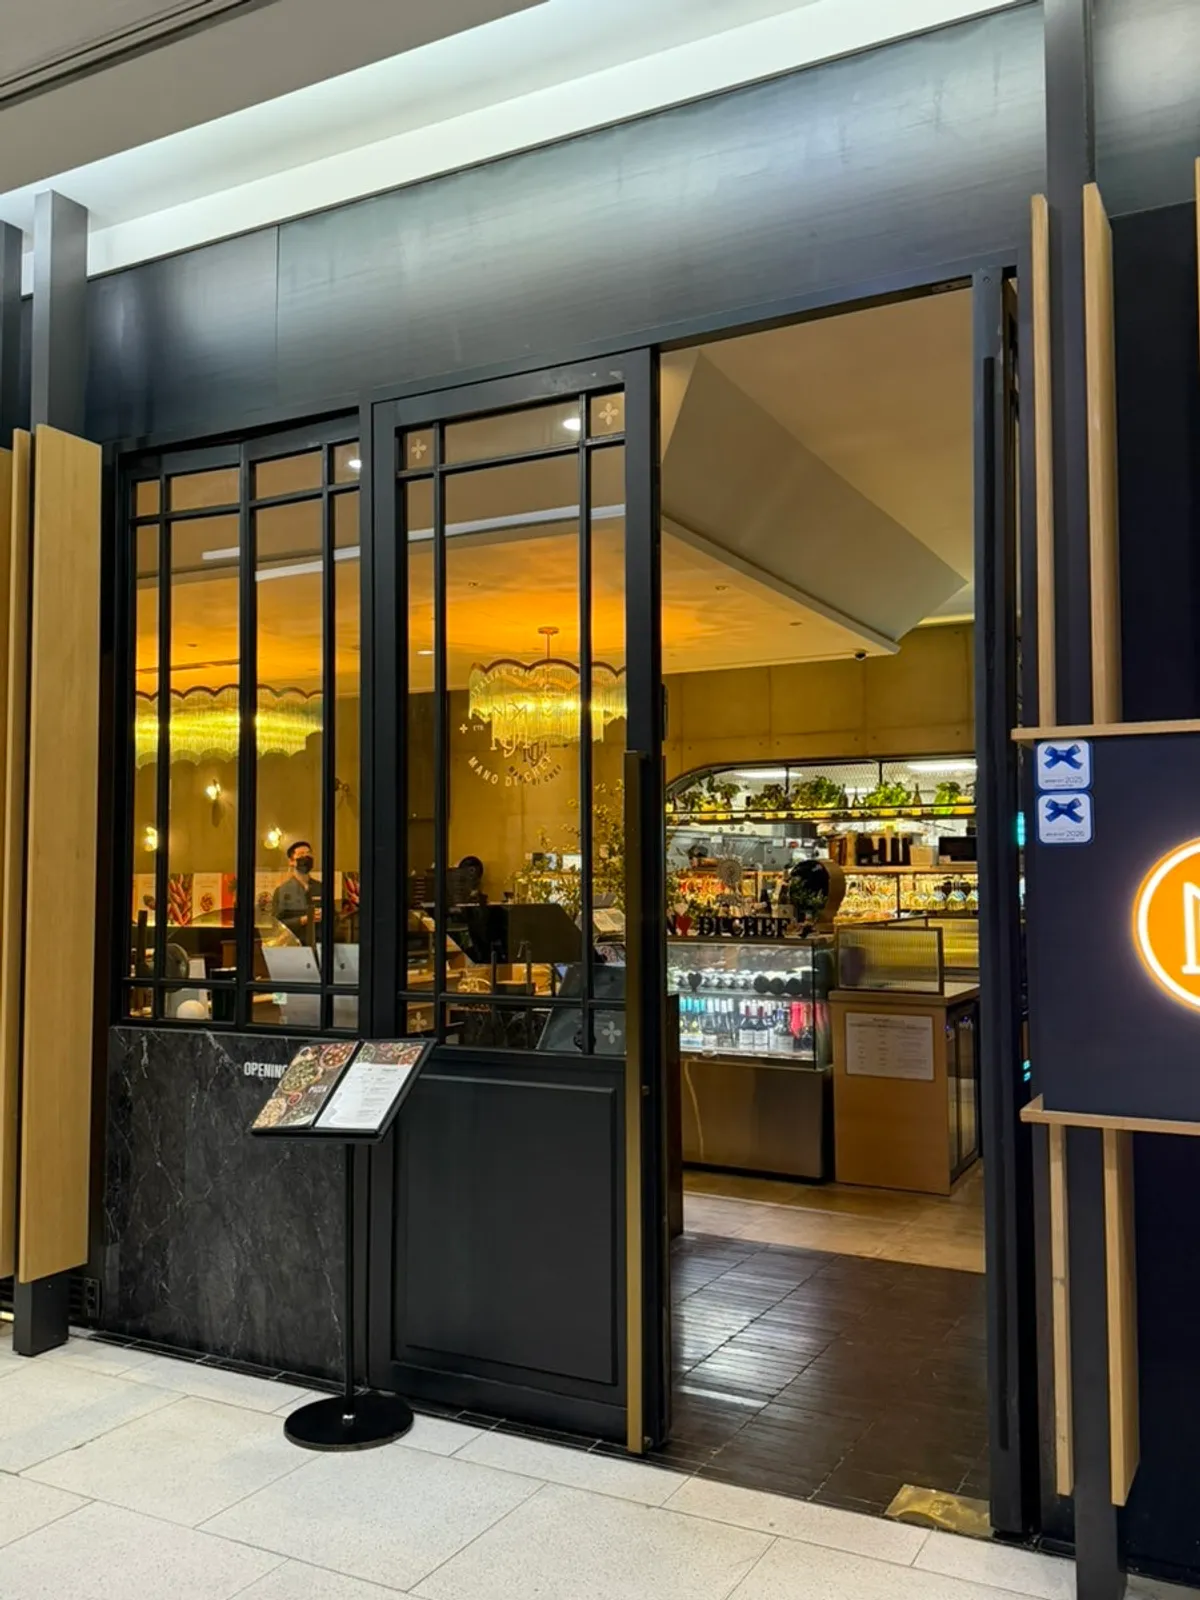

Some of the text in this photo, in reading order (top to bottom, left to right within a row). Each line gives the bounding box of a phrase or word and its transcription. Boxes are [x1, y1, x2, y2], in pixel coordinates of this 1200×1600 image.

[468, 756, 499, 785] MANO
[505, 776, 518, 787] DI
[524, 752, 552, 782] CHEF
